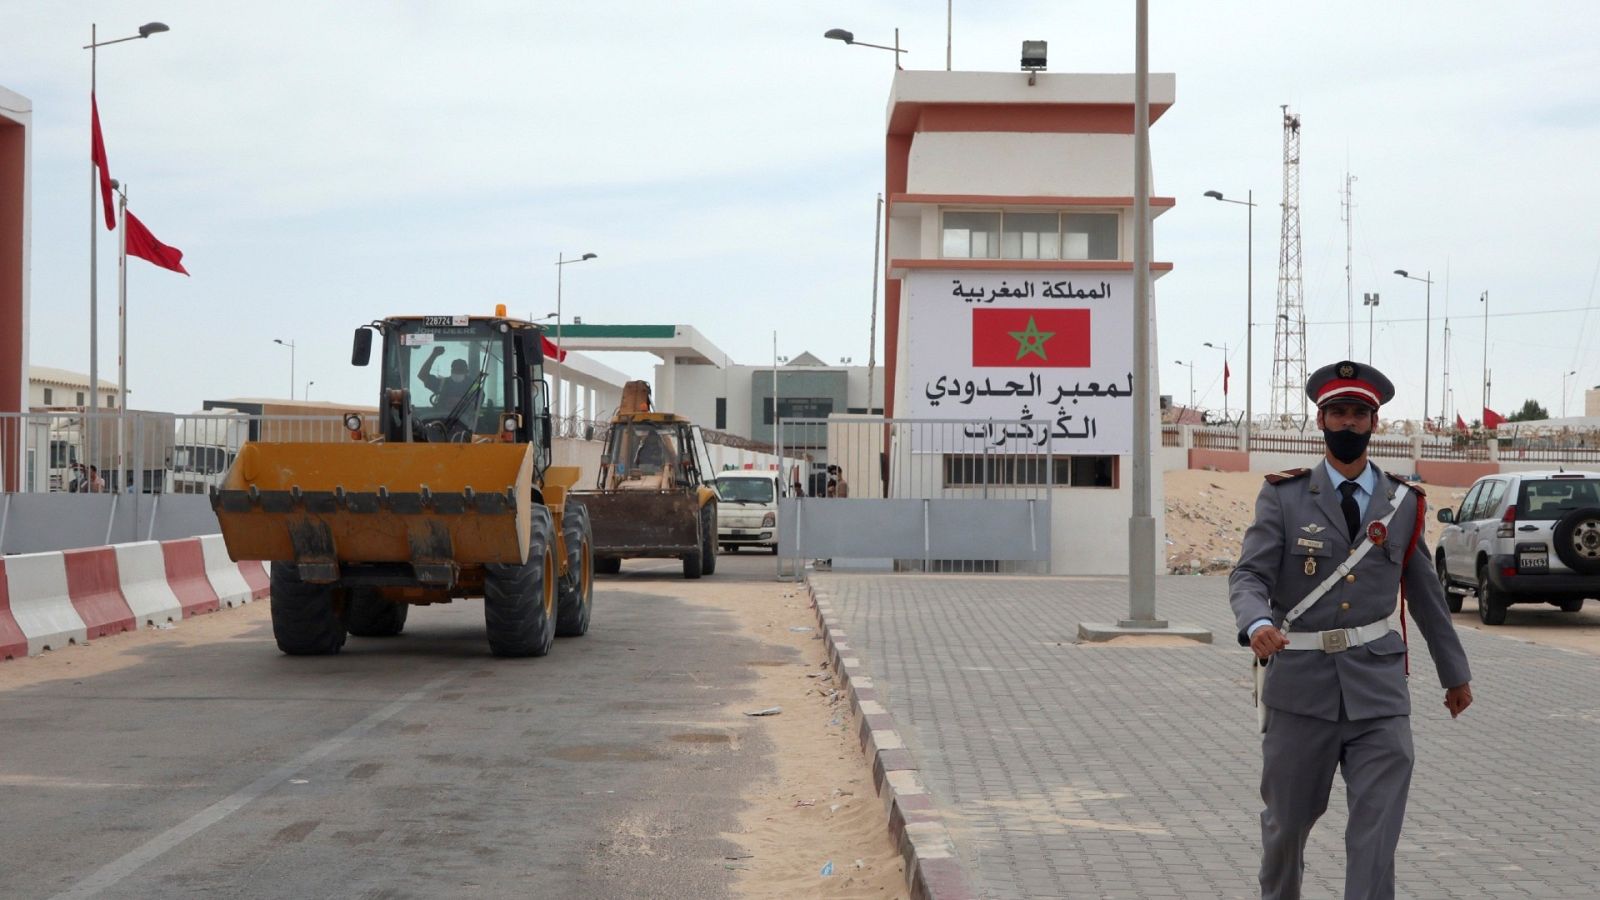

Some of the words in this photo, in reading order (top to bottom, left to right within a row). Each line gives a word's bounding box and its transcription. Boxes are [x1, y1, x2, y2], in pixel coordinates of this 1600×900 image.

[952, 280, 1034, 303] المغربية
[1042, 280, 1111, 299] المملكة
[925, 371, 1042, 407] الحدودي
[1047, 371, 1134, 405] لمعبر
